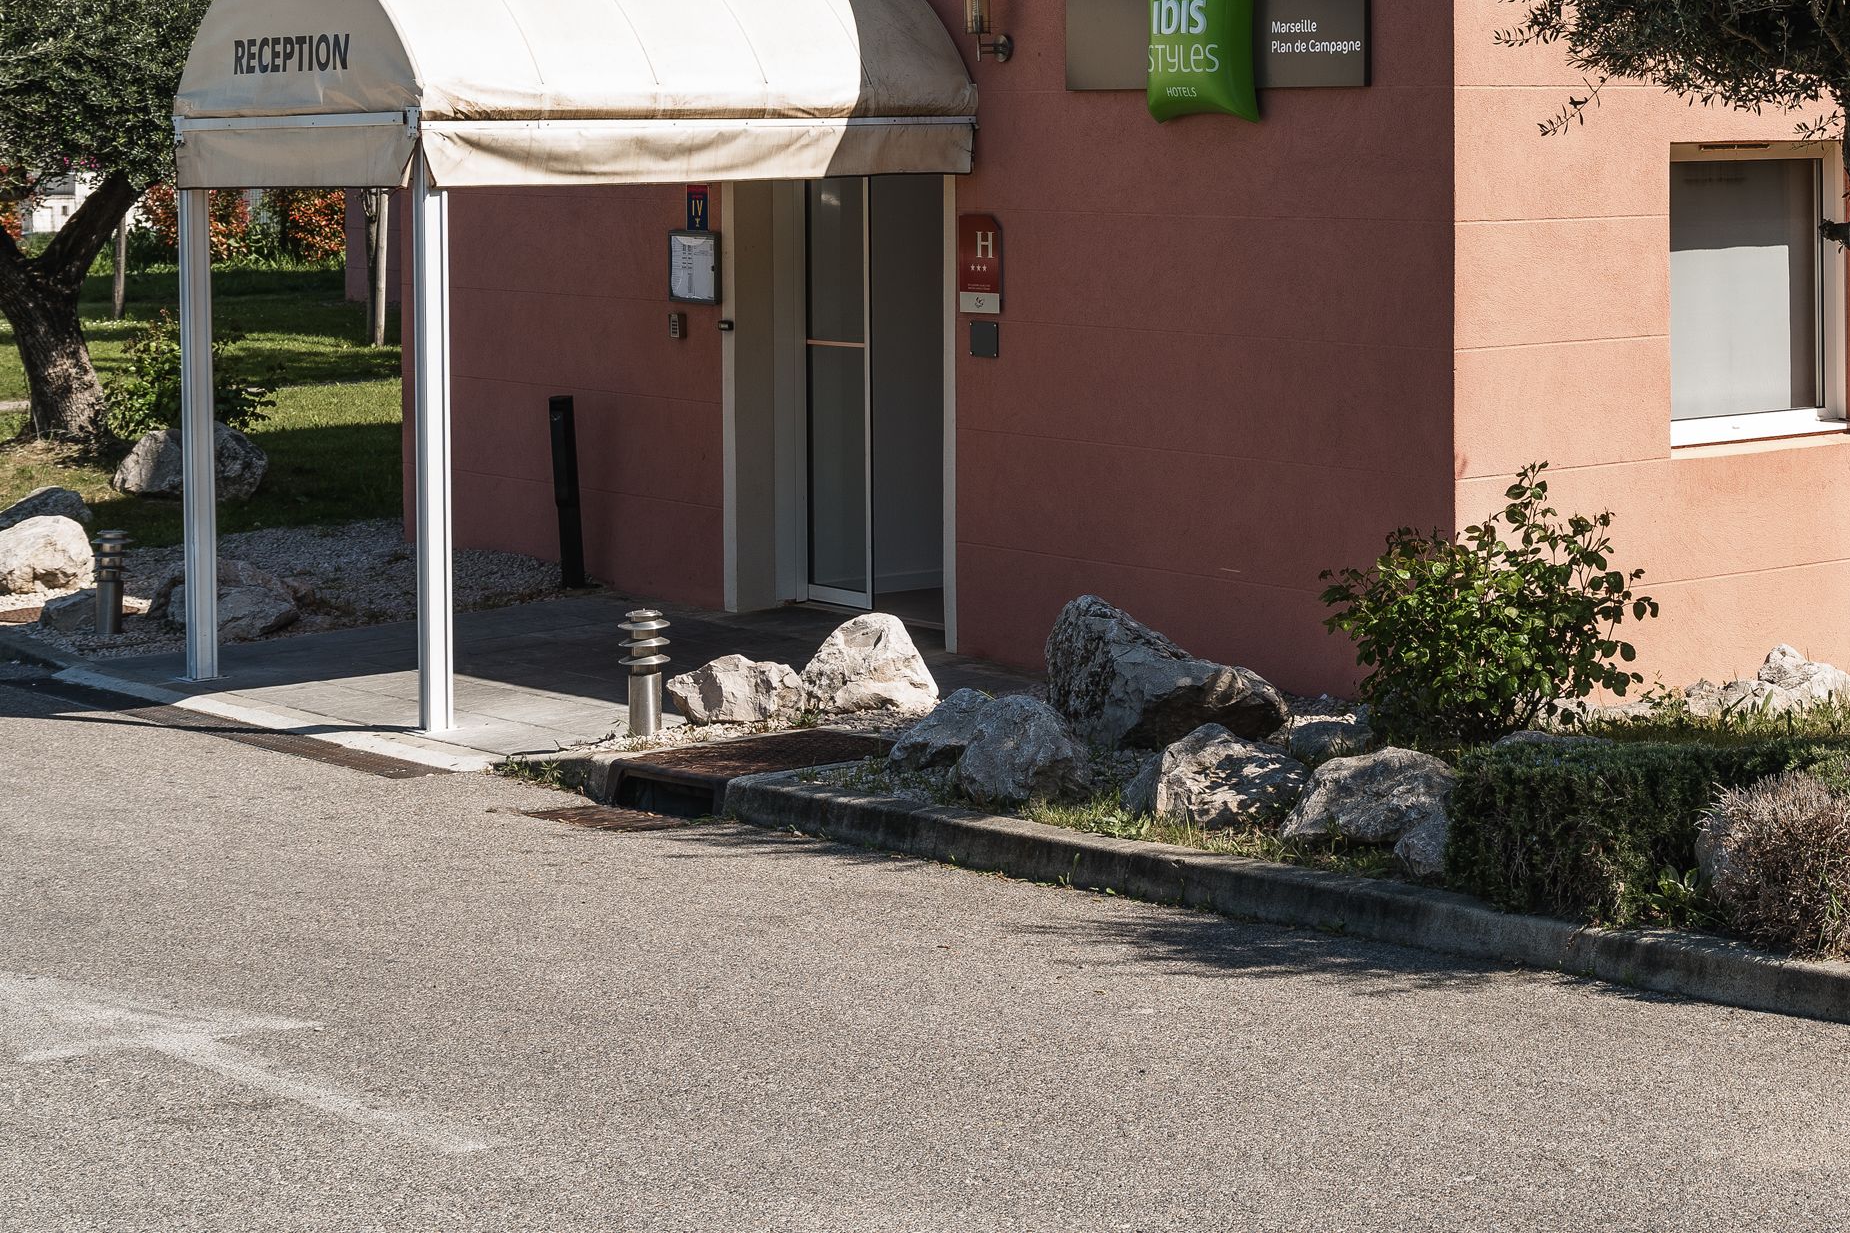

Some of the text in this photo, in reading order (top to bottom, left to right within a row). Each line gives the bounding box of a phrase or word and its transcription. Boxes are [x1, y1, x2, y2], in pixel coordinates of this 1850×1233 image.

[1271, 19, 1317, 33] Marseille
[1271, 40, 1361, 54] Plan de Campagne
[233, 34, 350, 75] RECEPTION
[1166, 86, 1197, 97] HOTELS
[975, 231, 995, 258] H
